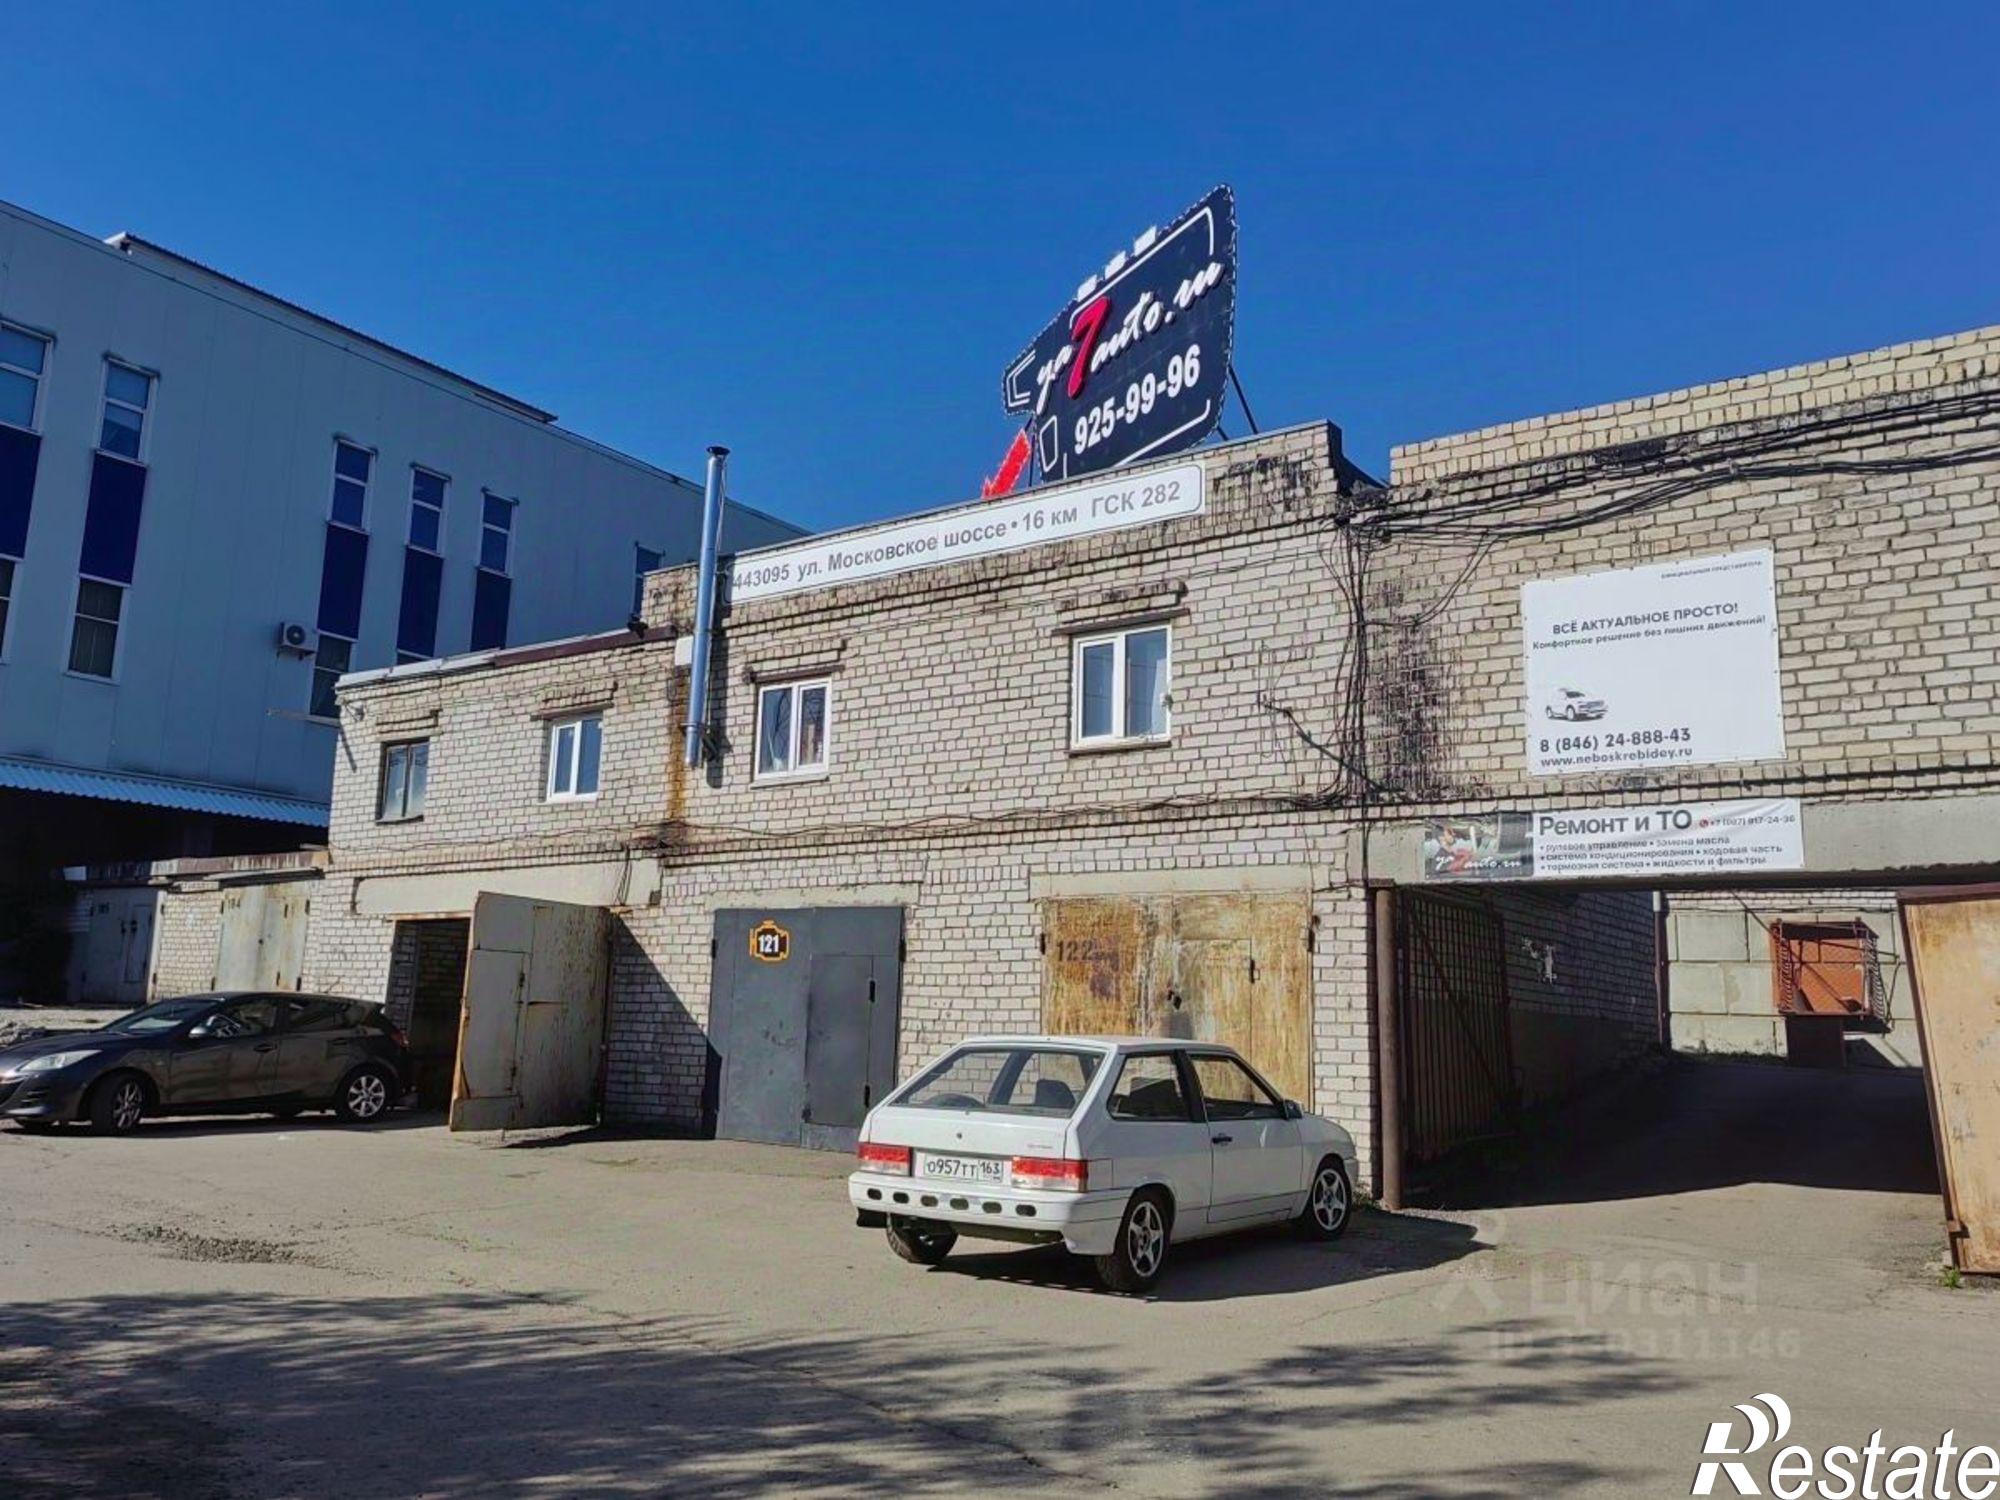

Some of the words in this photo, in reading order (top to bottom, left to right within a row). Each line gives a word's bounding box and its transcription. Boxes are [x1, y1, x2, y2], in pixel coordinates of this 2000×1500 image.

[1074, 343, 1202, 455] 925-99-96
[733, 563, 790, 591] 443095
[797, 562, 822, 583] ул.
[828, 534, 938, 572] Московское
[944, 522, 1007, 548] шоссе
[1022, 510, 1044, 531] 16
[1051, 506, 1078, 526] км
[1091, 490, 1136, 518] ГСК
[1141, 481, 1181, 508] 282
[1533, 636, 1593, 650] Комфортное
[1596, 630, 1642, 645] решение
[1644, 626, 1662, 637] без
[1664, 624, 1705, 635] лишних
[1707, 615, 1766, 632] движений!
[1553, 620, 1578, 635] ВСЁ
[1581, 611, 1669, 632] АКТУАЛЬНОЕ
[1674, 602, 1739, 621] ПРОСТО!
[1540, 739, 1549, 753] 8
[1555, 736, 1599, 754] (846)
[1605, 728, 1691, 748] 24-888-43
[1540, 816, 1629, 836] Ремонт
[1634, 816, 1650, 831] и
[1656, 809, 1692, 831] ТО
[758, 934, 779, 953] 121
